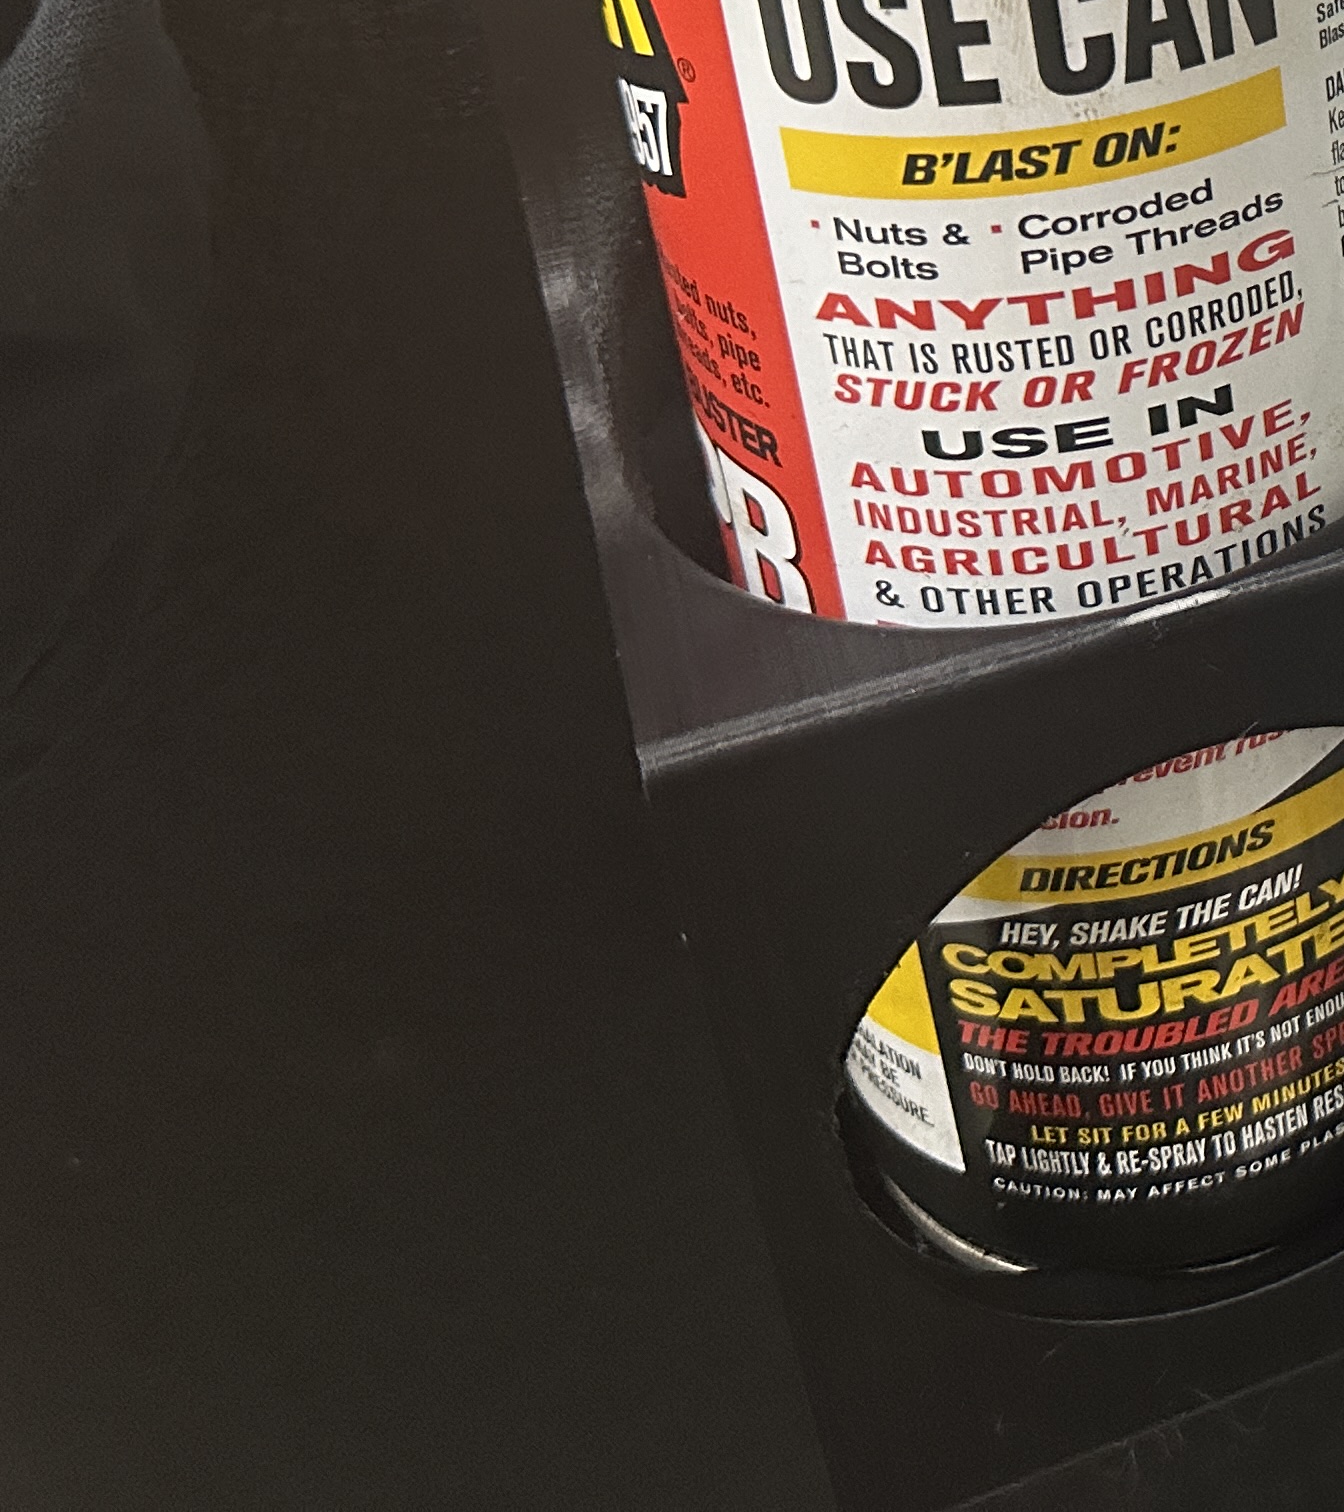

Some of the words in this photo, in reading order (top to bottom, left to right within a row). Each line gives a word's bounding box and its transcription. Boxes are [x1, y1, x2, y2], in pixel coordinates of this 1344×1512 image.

[901, 139, 1082, 187] B'LAST
[1093, 121, 1181, 168] ON:
[832, 216, 929, 248] Nuts
[941, 222, 970, 246] &
[1017, 177, 1215, 241] Corroded
[1020, 239, 1115, 276] Pipe
[1126, 191, 1285, 257] Threads
[814, 228, 1298, 332] ANYTHING
[838, 251, 940, 282] Bolts
[717, 331, 762, 372] pipe
[822, 332, 894, 373] THAT
[908, 342, 940, 375] IS
[952, 333, 1075, 376] RUSTED
[1089, 324, 1132, 360] OR
[1145, 269, 1304, 347] CORRODED,
[833, 373, 1004, 413] STUCK
[1022, 369, 1098, 409] OR
[1117, 300, 1306, 394] FROZEN
[850, 397, 1313, 500] AUTOMOTIVE,
[920, 416, 1115, 461] USE
[1147, 383, 1237, 437] IN
[853, 498, 1128, 538] INDUSTRIAL,
[1145, 430, 1319, 518] MARINE,
[864, 470, 1323, 578] AGRICULTURAL
[875, 579, 905, 609] &
[920, 585, 1057, 618] OTHER
[1076, 502, 1327, 610] OPERATIONS
[1020, 818, 1276, 894] DIRECTIONS
[1000, 919, 1061, 951] HEY,
[1069, 910, 1168, 946] SHAKE
[1175, 896, 1231, 931] THE
[1238, 863, 1304, 912] CAN!
[956, 1019, 1028, 1055] THE
[1041, 1000, 1259, 1058] TROUBLED
[1012, 1061, 1056, 1084] HOLD
[1059, 1061, 1112, 1085] BACK!
[1119, 1062, 1138, 1082] IF
[1142, 1054, 1177, 1079] YOU
[1180, 1041, 1232, 1075] THINK
[1270, 1016, 1302, 1045] NOT
[968, 1079, 1000, 1110] GO
[1099, 1089, 1154, 1119] GIVE
[1161, 1082, 1187, 1110] IT
[1196, 1049, 1302, 1104] ANOTHER
[984, 1138, 1017, 1169] TAP
[1020, 1146, 1091, 1176] LIGHTLY
[1096, 1155, 1114, 1176] &
[1116, 1137, 1208, 1176] RE-SPRAY
[1211, 1128, 1239, 1160] TO
[1241, 1101, 1310, 1149] HASTEN
[1031, 1123, 1073, 1145] LET
[1077, 1125, 1114, 1146] SIT
[1121, 1120, 1168, 1144] FOR
[1174, 1116, 1191, 1137] A
[1197, 1103, 1244, 1131] FEW
[1096, 1186, 1138, 1202] MAY
[1148, 1170, 1226, 1199] AFFECT
[1233, 1146, 1293, 1179] SOME
